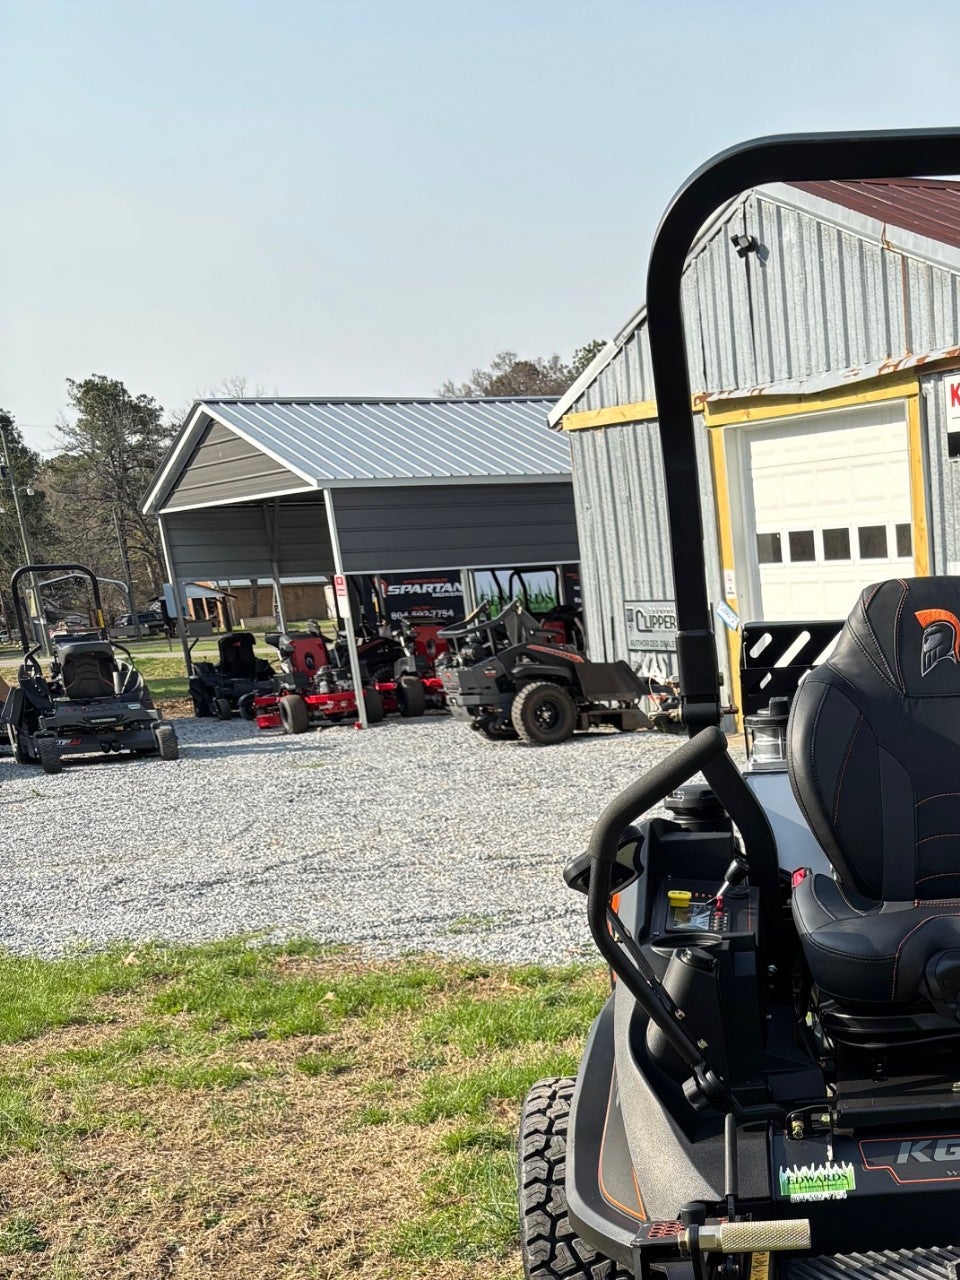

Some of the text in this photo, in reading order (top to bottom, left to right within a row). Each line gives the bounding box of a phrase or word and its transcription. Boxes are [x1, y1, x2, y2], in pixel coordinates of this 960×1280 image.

[387, 582, 463, 595] SPARTAN
[635, 609, 676, 632] CLIPPER
[660, 640, 677, 649] DEALE
[787, 1172, 849, 1186] EDWARDS
